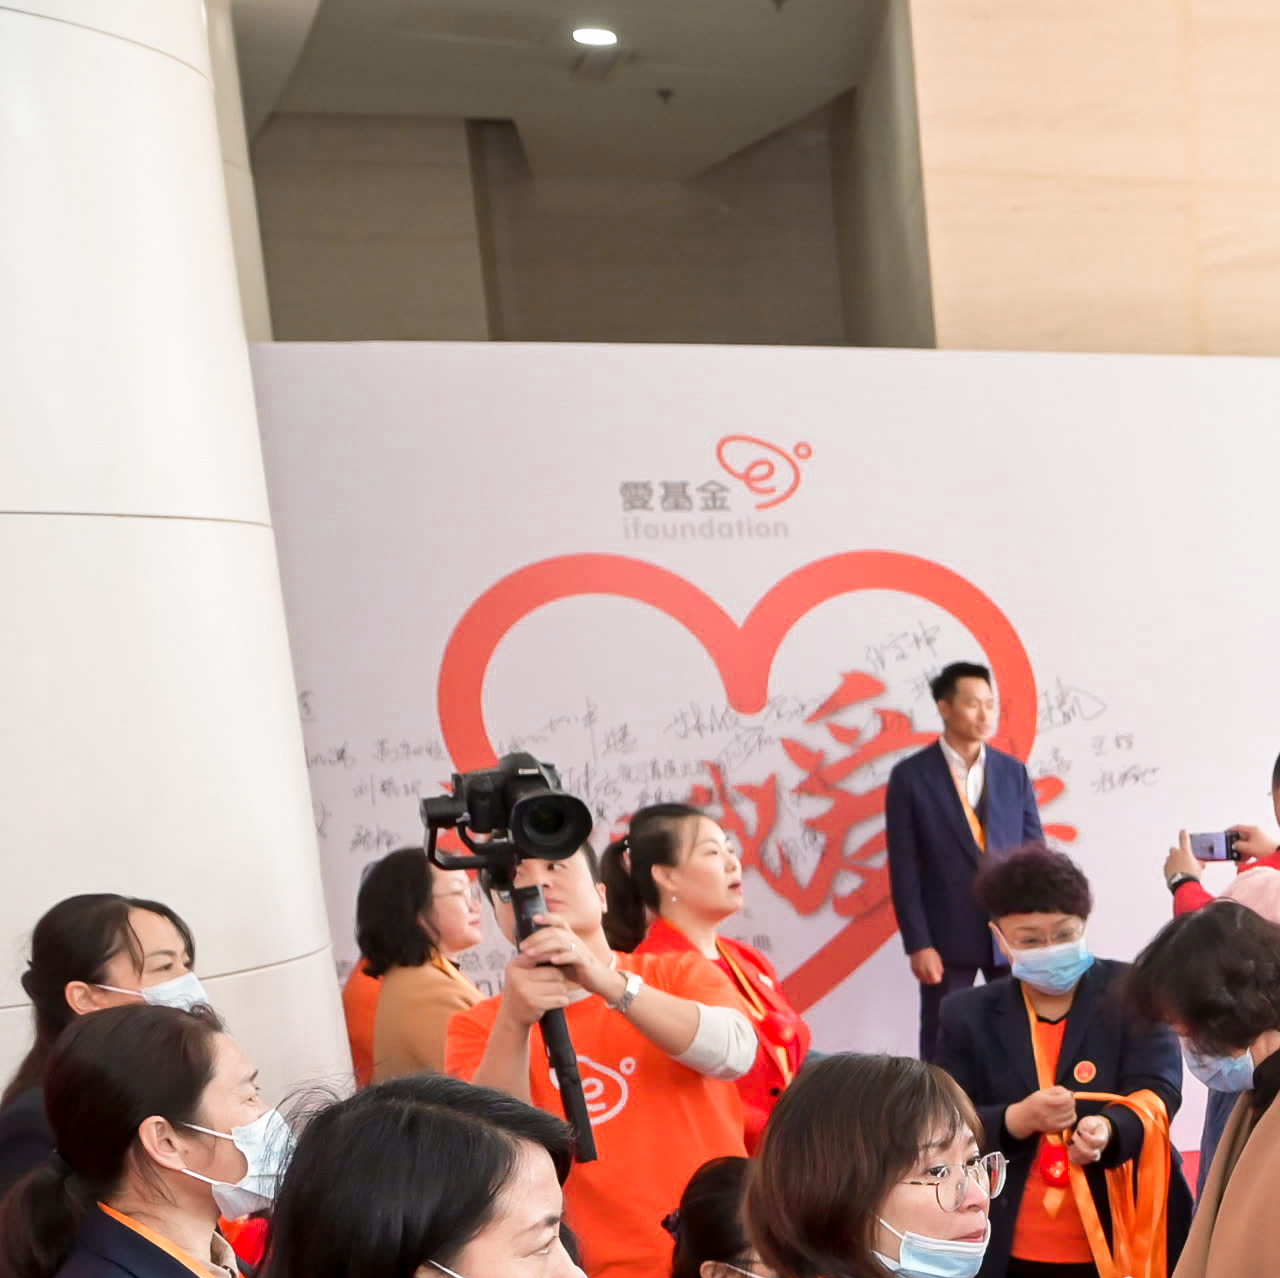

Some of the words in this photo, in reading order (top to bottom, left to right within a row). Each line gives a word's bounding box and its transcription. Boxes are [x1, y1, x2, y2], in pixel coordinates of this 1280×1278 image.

[619, 480, 731, 512] 愛基金
[623, 516, 788, 539] ifoundation
